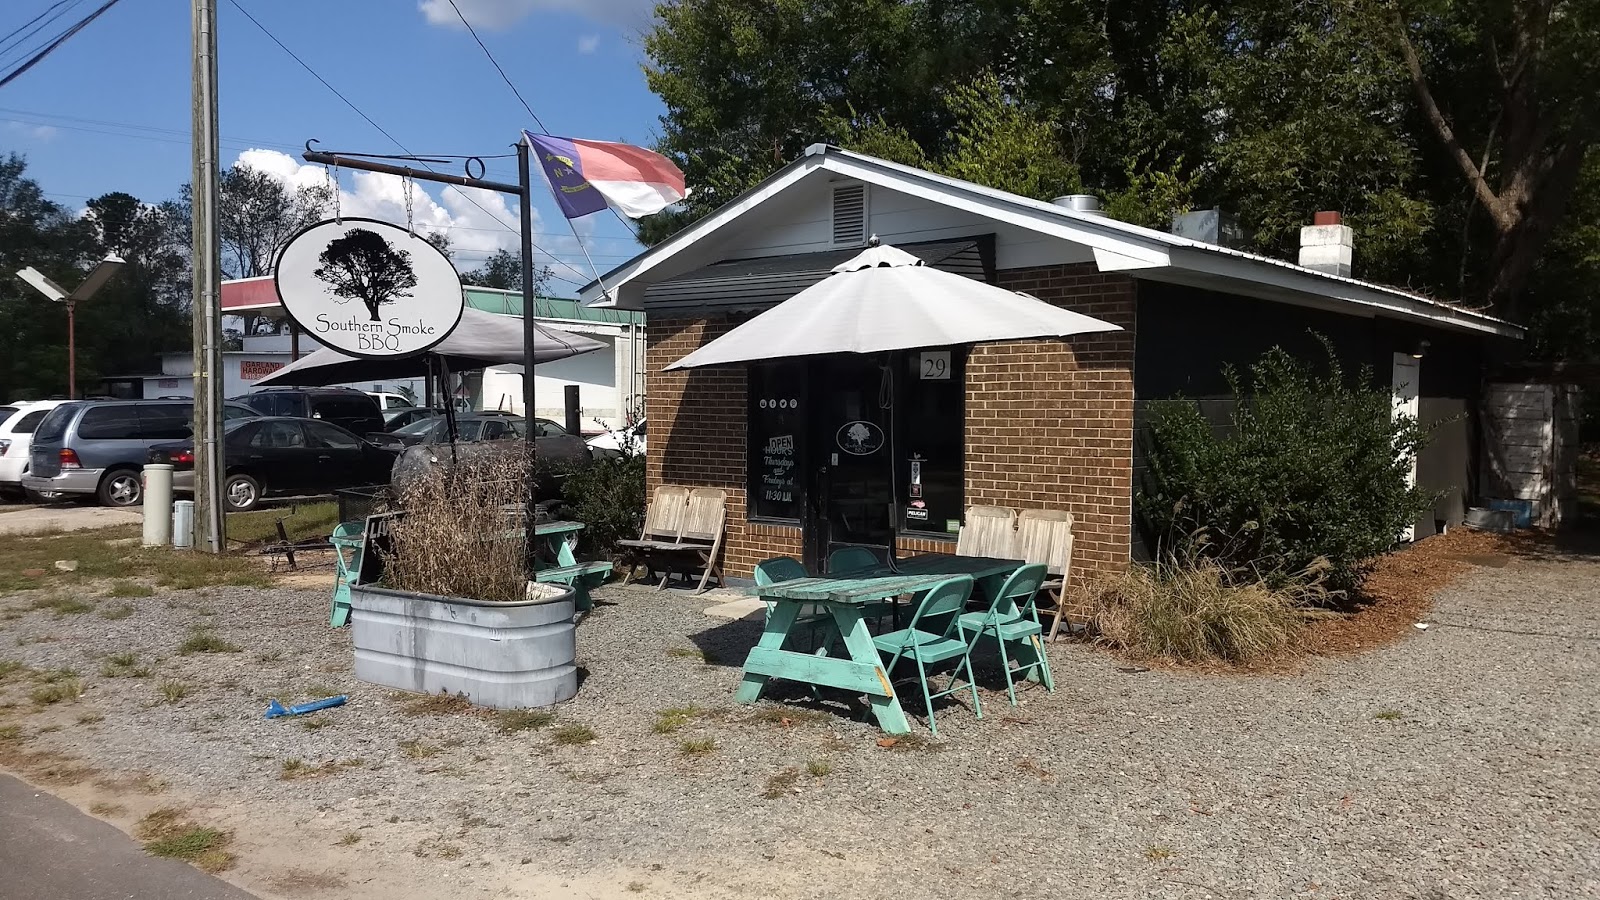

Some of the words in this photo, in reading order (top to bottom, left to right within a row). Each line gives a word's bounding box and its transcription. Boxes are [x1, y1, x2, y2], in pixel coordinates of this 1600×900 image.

[315, 313, 383, 333] Southern
[386, 317, 435, 337] Smoke
[358, 333, 403, 352] BBQ
[242, 367, 281, 375] HARDWA
[924, 358, 946, 378] 29
[771, 437, 792, 449] OPEN
[763, 456, 794, 470] Thursdays
[762, 474, 786, 489] Fridays
[765, 490, 782, 501] 11:30
